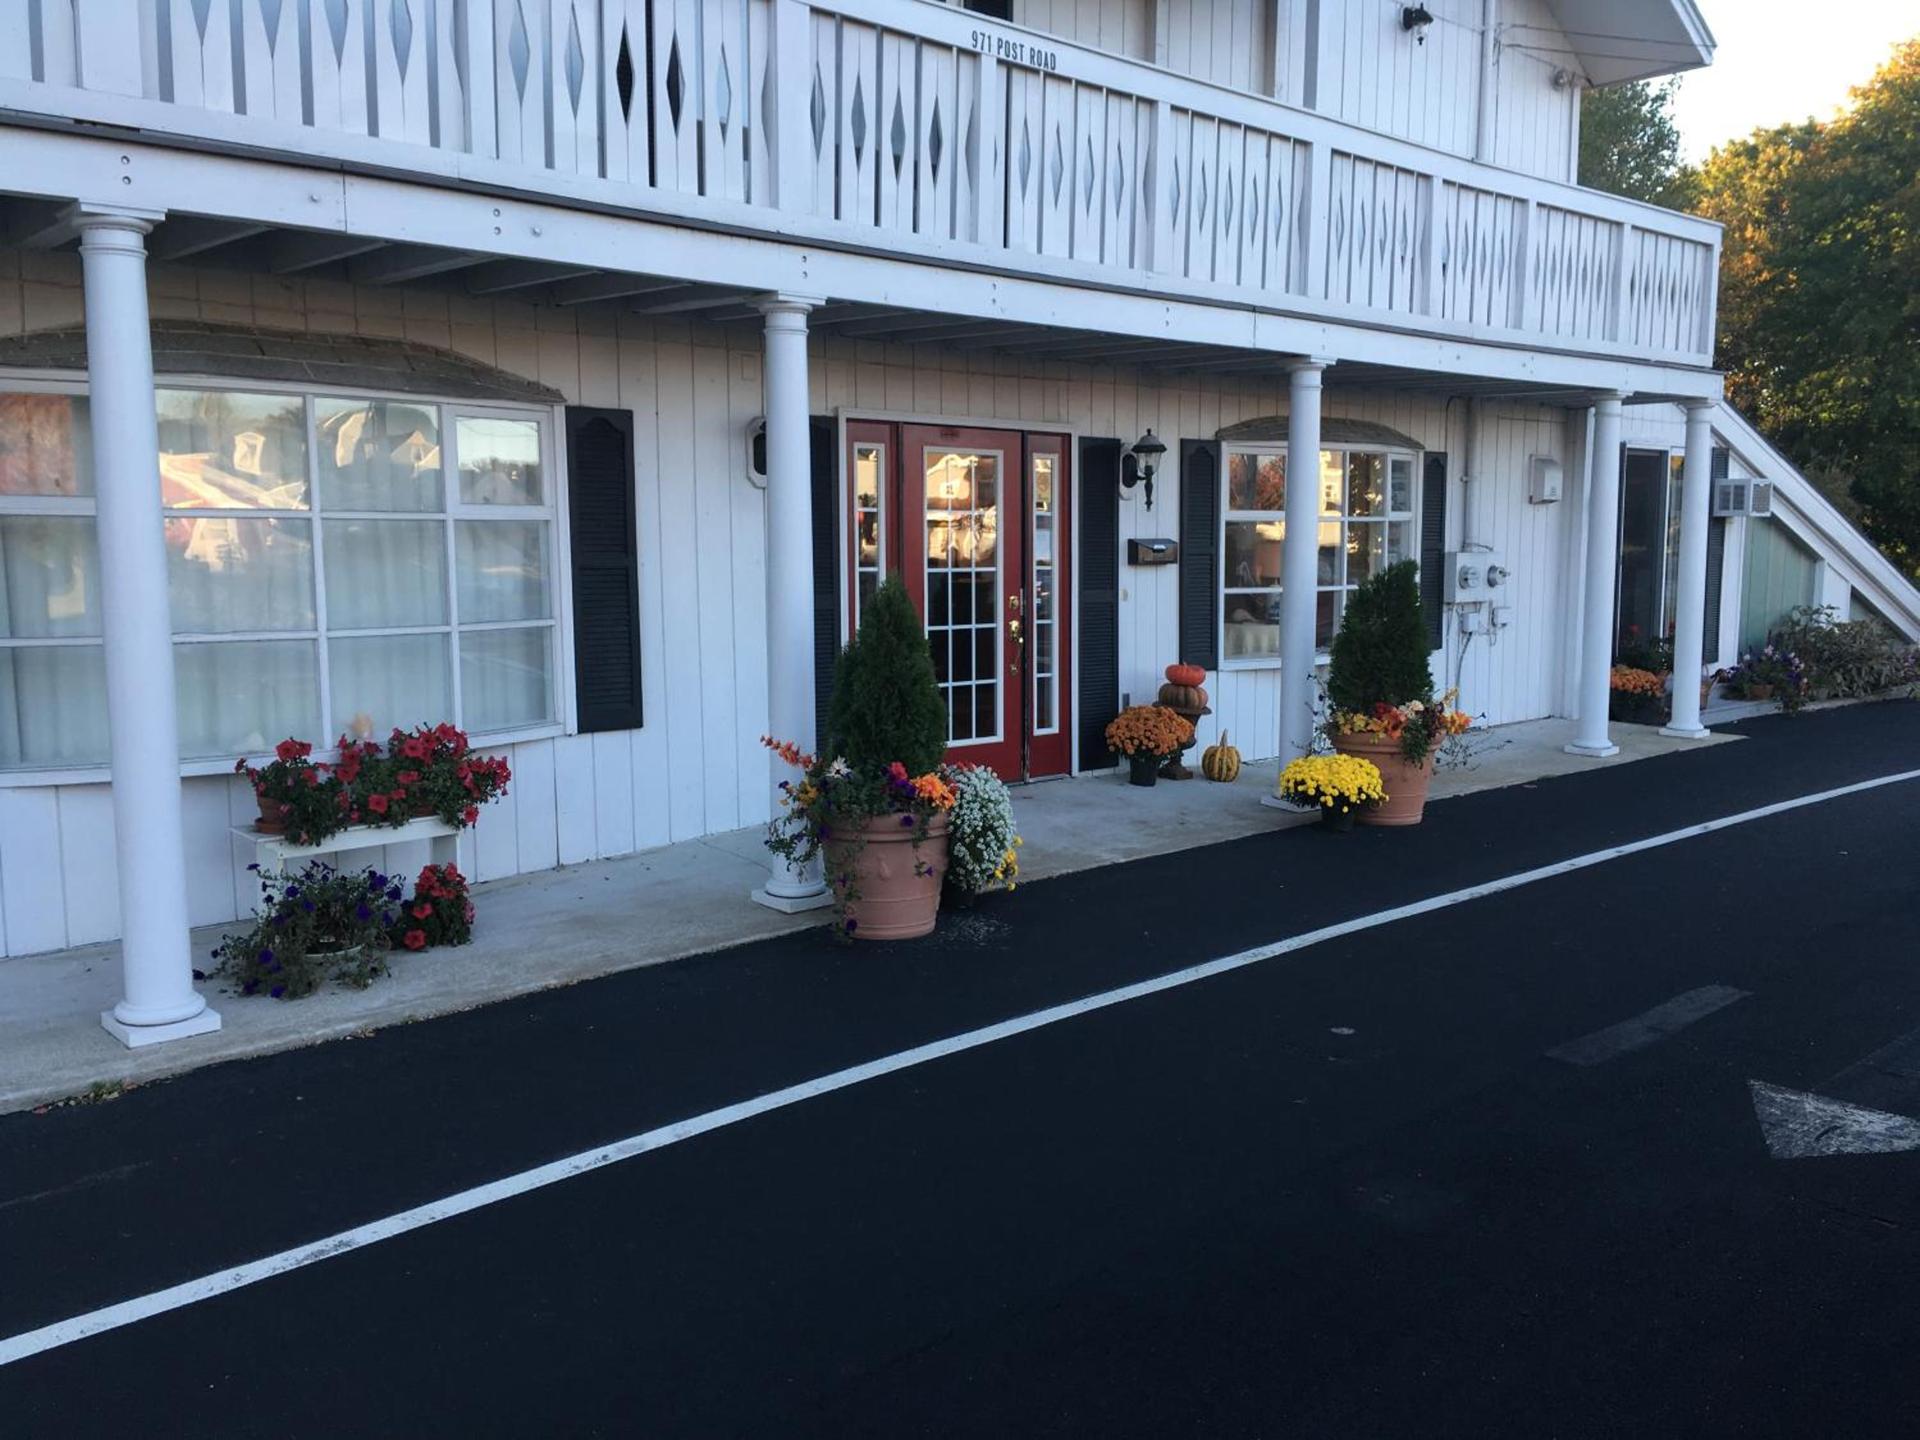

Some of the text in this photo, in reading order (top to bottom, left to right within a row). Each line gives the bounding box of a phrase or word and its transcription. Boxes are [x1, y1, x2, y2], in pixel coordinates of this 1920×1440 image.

[972, 30, 1056, 71] 971 POST ROAD
